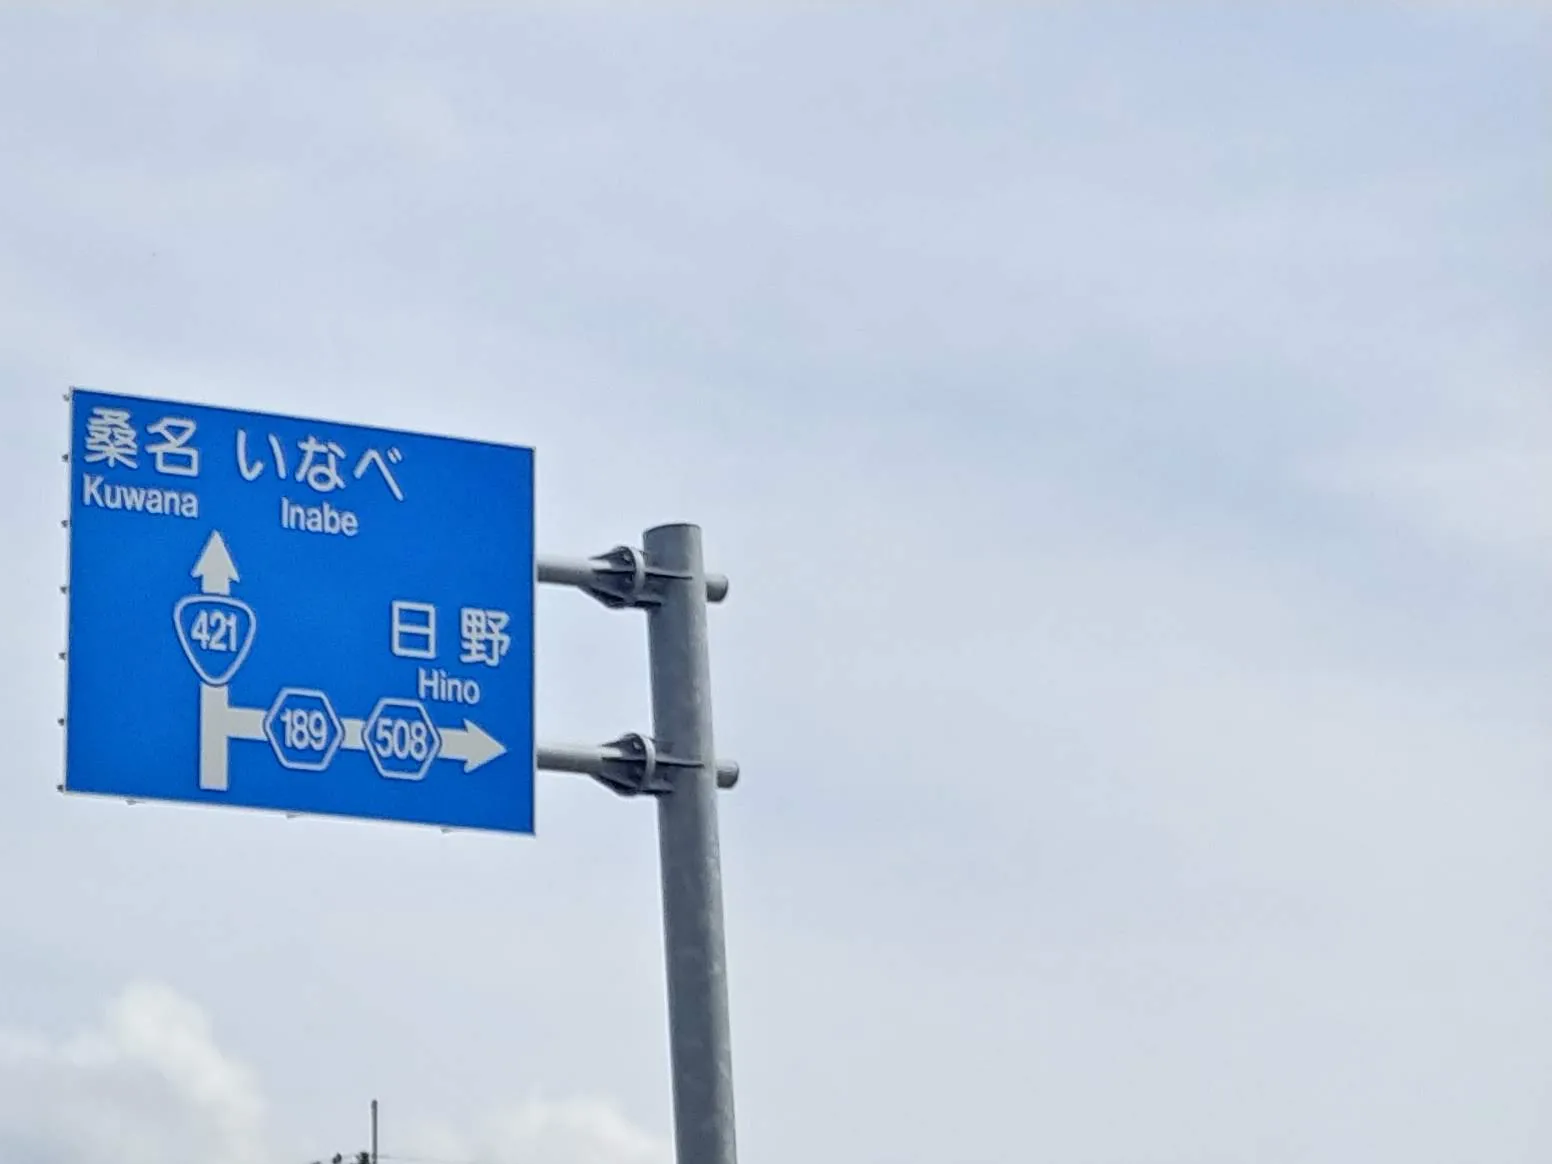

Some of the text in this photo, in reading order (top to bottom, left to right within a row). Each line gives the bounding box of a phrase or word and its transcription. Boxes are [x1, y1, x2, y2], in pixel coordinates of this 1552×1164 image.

[85, 406, 405, 501] 桑名 いなべ
[83, 474, 359, 536] Kuwana Inabe
[190, 608, 238, 653] 421
[392, 600, 510, 667] 日野
[417, 670, 481, 706] Hino
[281, 707, 430, 763] 189 508
